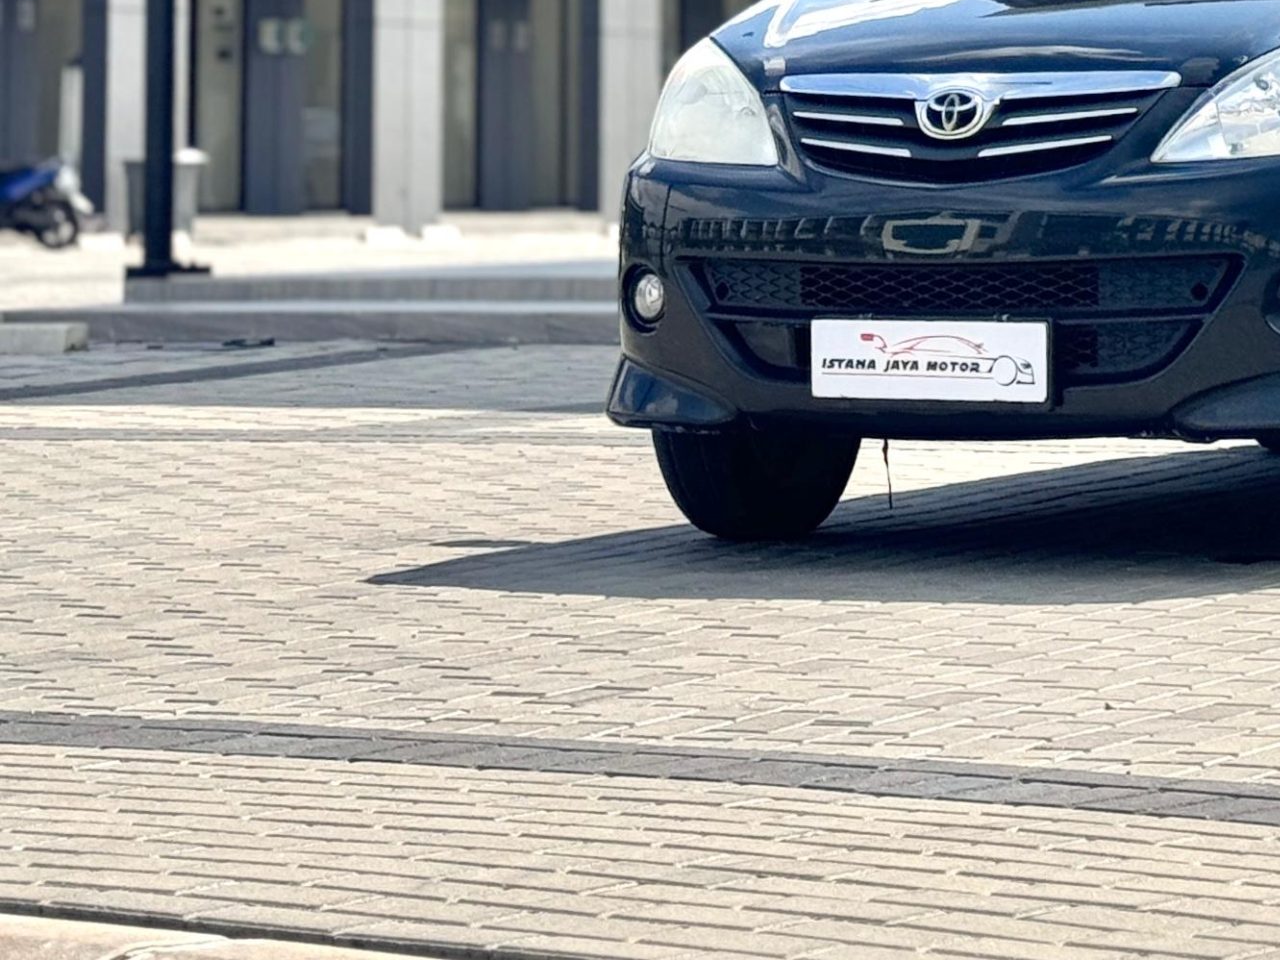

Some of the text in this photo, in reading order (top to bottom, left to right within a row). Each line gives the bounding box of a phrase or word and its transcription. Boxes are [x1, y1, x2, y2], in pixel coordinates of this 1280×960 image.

[821, 357, 981, 374] ISTANA JAYA MOTOR
